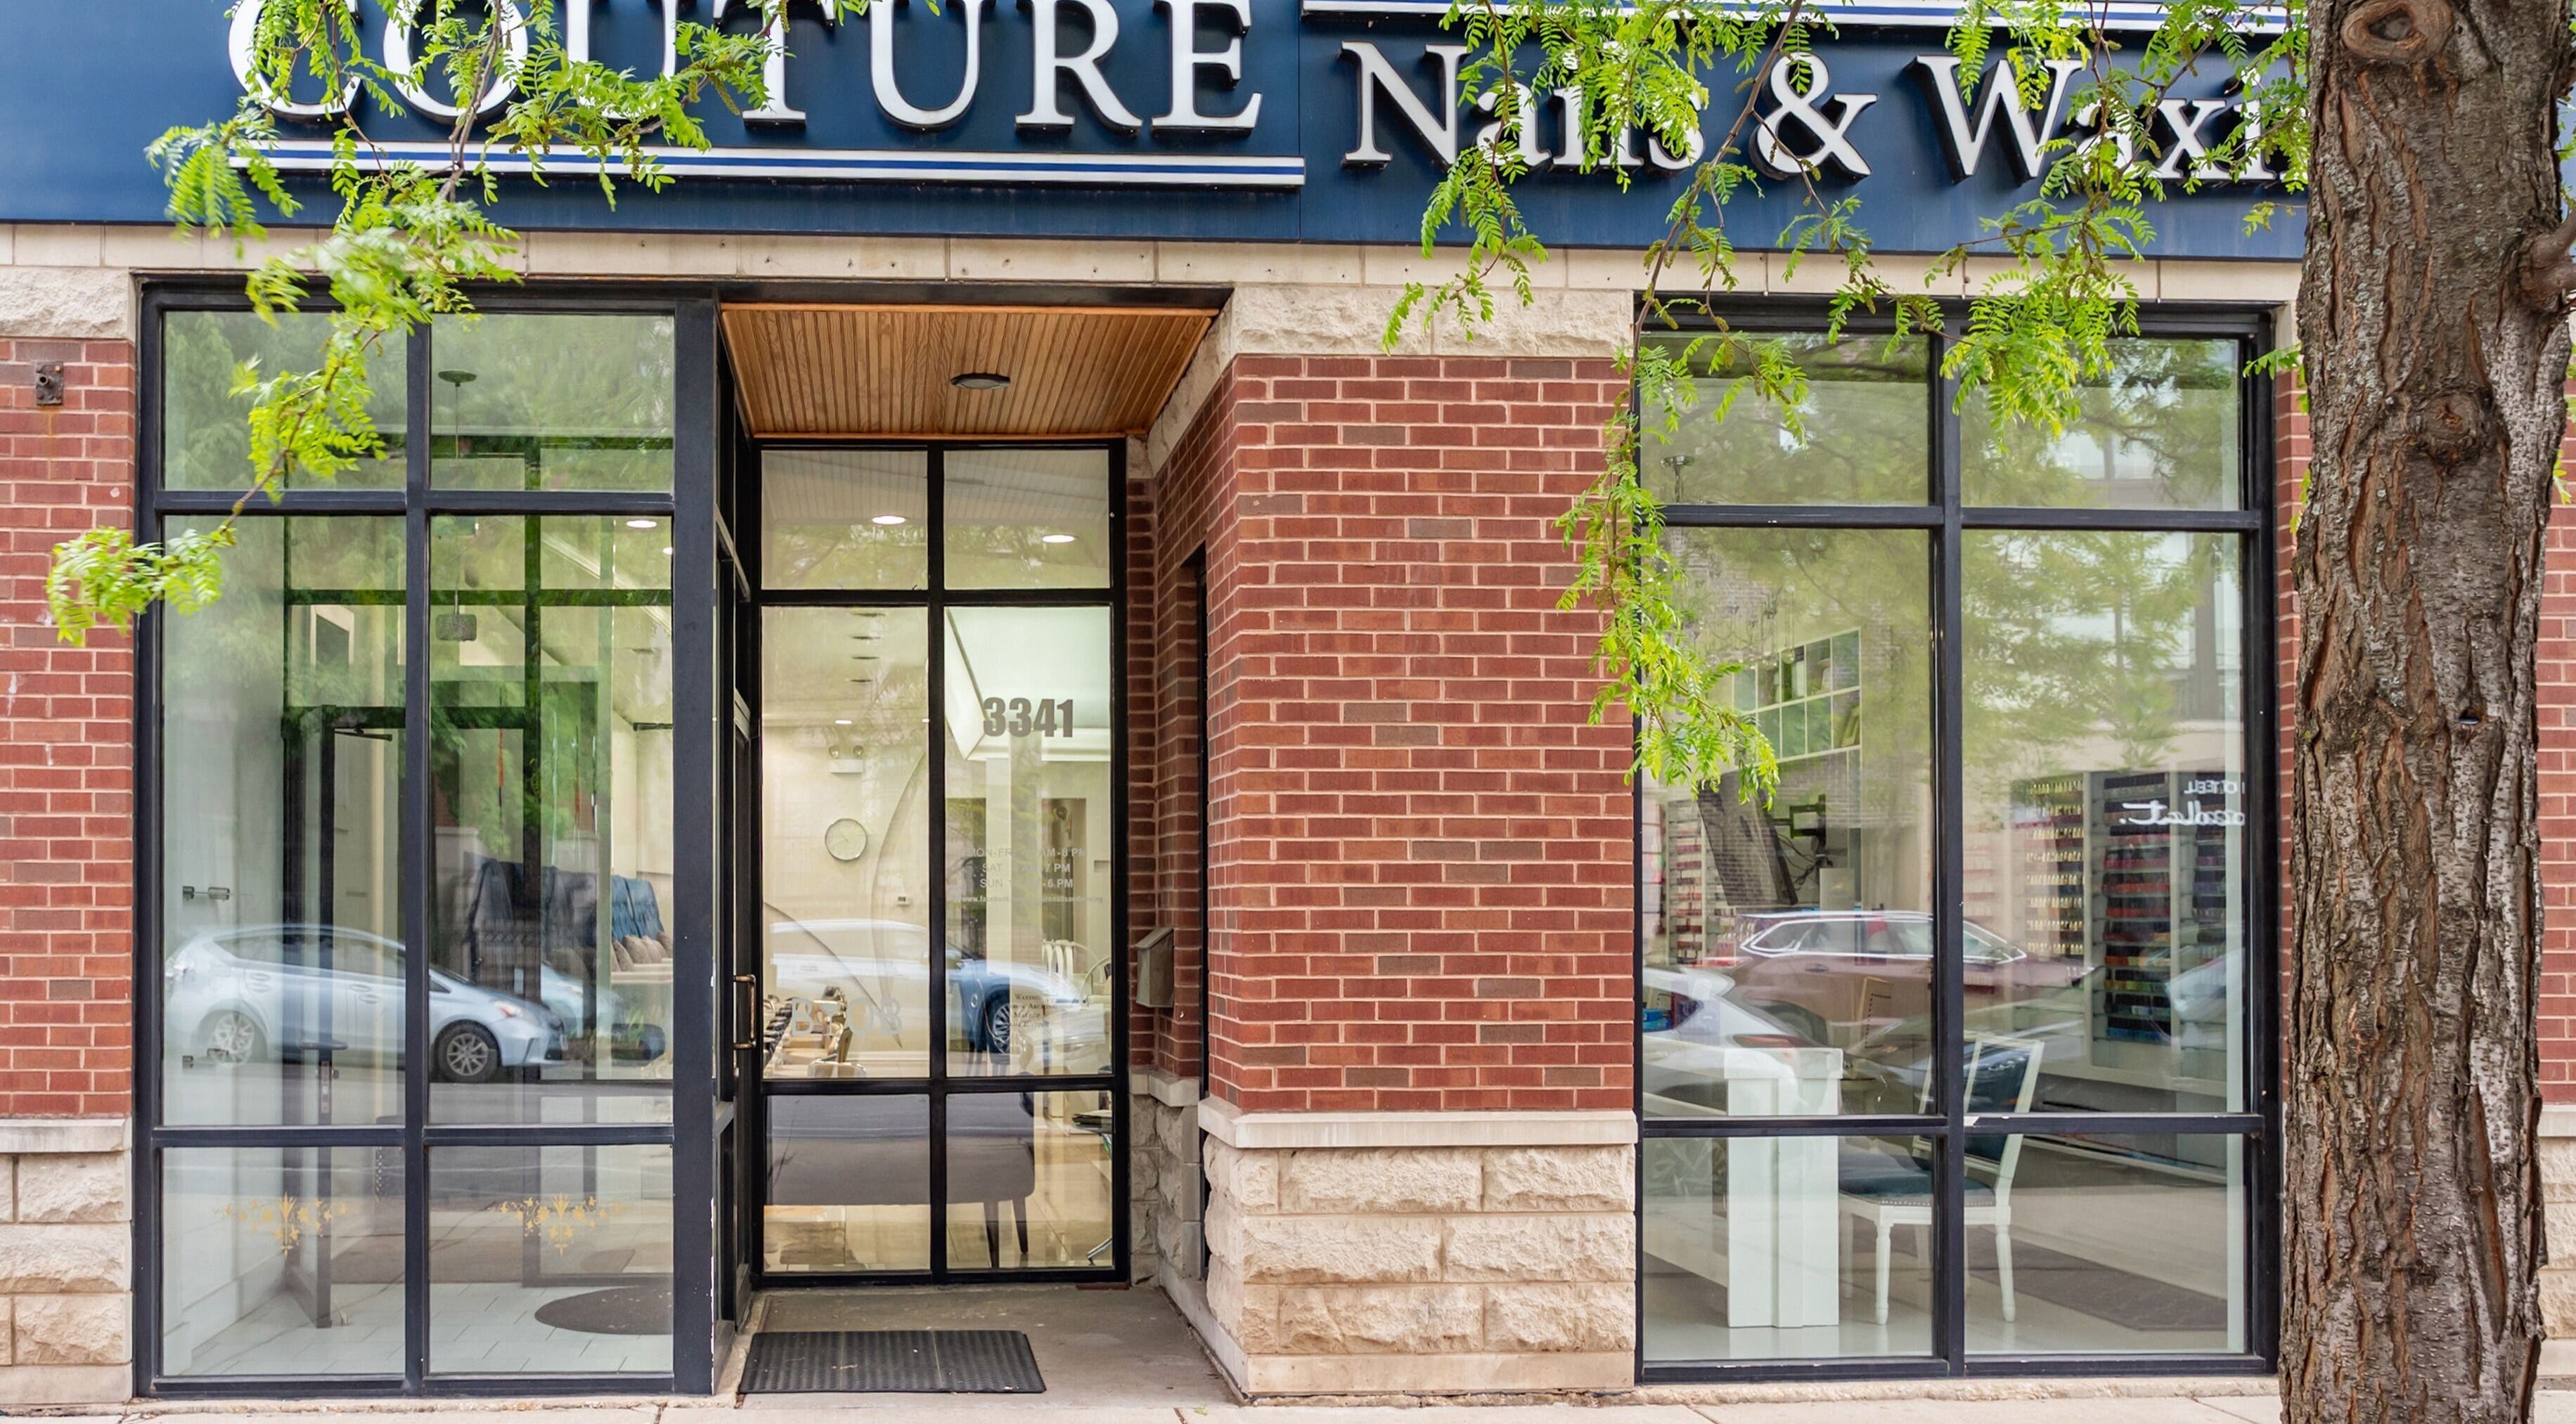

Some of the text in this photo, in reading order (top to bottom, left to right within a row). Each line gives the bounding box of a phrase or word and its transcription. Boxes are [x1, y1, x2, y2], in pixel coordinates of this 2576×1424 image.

[1757, 52, 1879, 176] &
[1915, 53, 2309, 181] Waxi
[983, 697, 1074, 738] 3341
[979, 879, 1003, 888] SUN
[1057, 879, 1074, 888] PM
[982, 863, 1003, 873] SAT
[1054, 863, 1071, 873] PM
[792, 997, 902, 1036] BYOB
